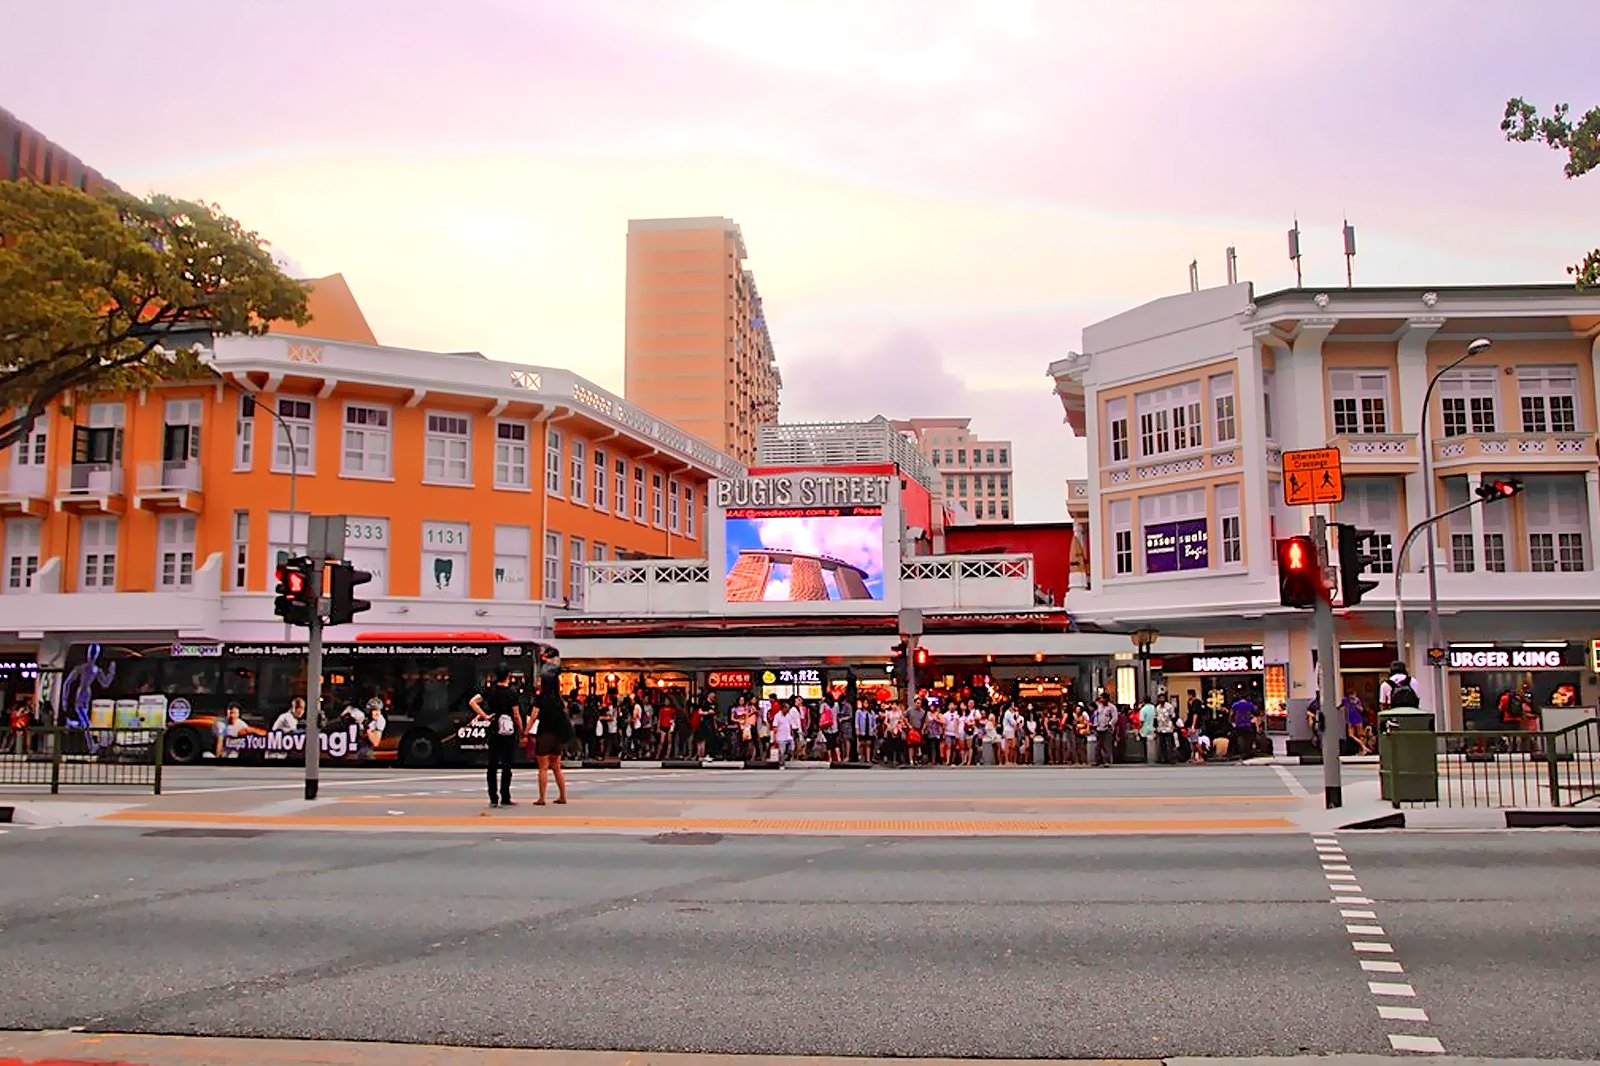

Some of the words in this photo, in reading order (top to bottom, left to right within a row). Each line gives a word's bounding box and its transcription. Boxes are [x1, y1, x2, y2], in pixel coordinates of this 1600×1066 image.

[717, 478, 792, 507] BUGIS
[800, 477, 890, 506] STREET
[427, 529, 463, 545] 1131
[1192, 656, 1249, 672] BURGER
[1450, 652, 1510, 667] URGER
[1512, 651, 1561, 666] KING
[267, 724, 358, 757] Movng!
[457, 727, 487, 739] 6744
